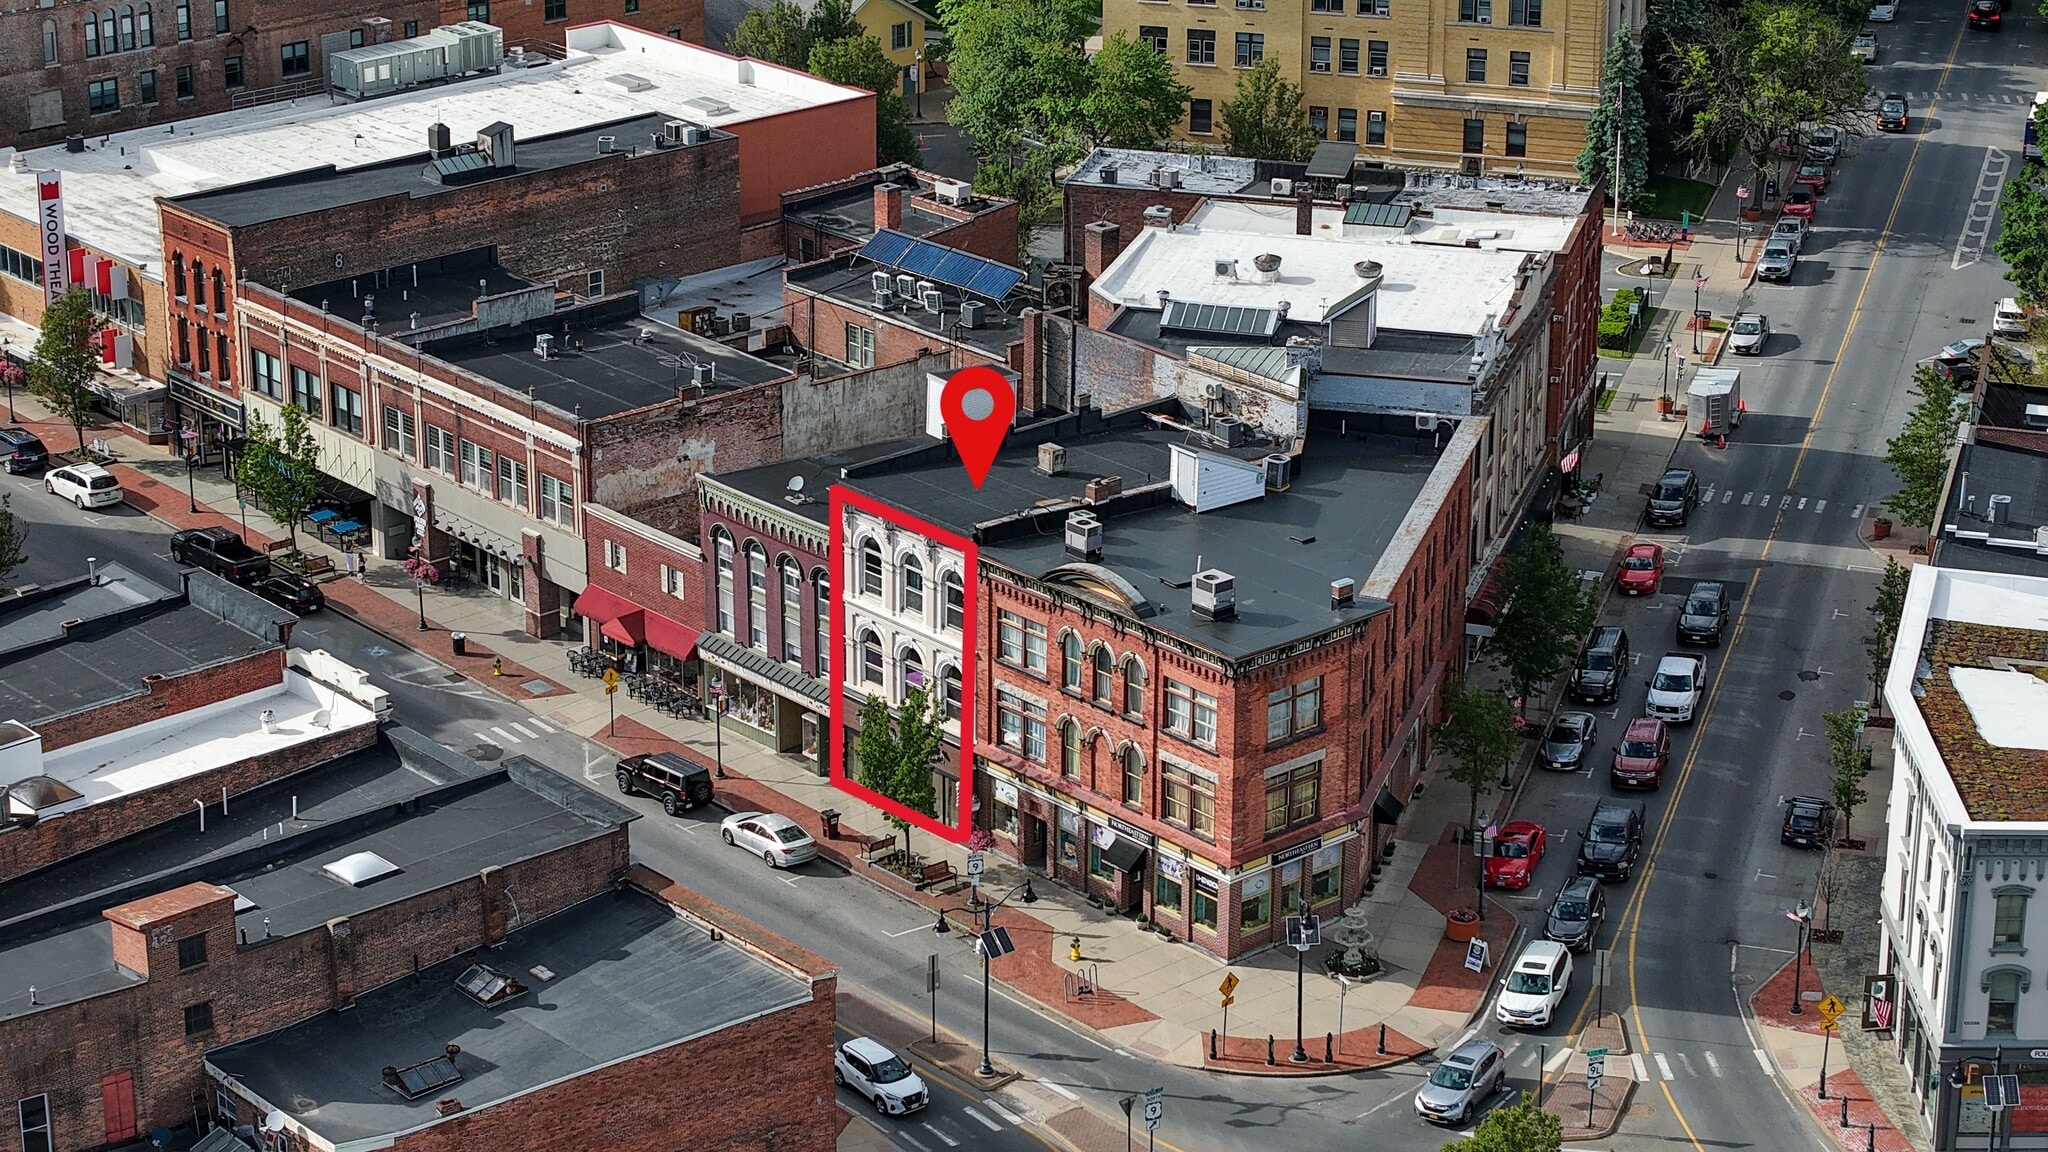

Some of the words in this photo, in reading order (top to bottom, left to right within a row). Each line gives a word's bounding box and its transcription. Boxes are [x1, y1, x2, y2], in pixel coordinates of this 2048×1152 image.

[45, 203, 59, 256] WOOD
[336, 253, 343, 268] 8
[1111, 820, 1149, 841] NORTHEASTERN
[1278, 841, 1318, 860] NORTHEASTERN
[1590, 1066, 1601, 1075] 9L
[1151, 1106, 1156, 1115] 9
